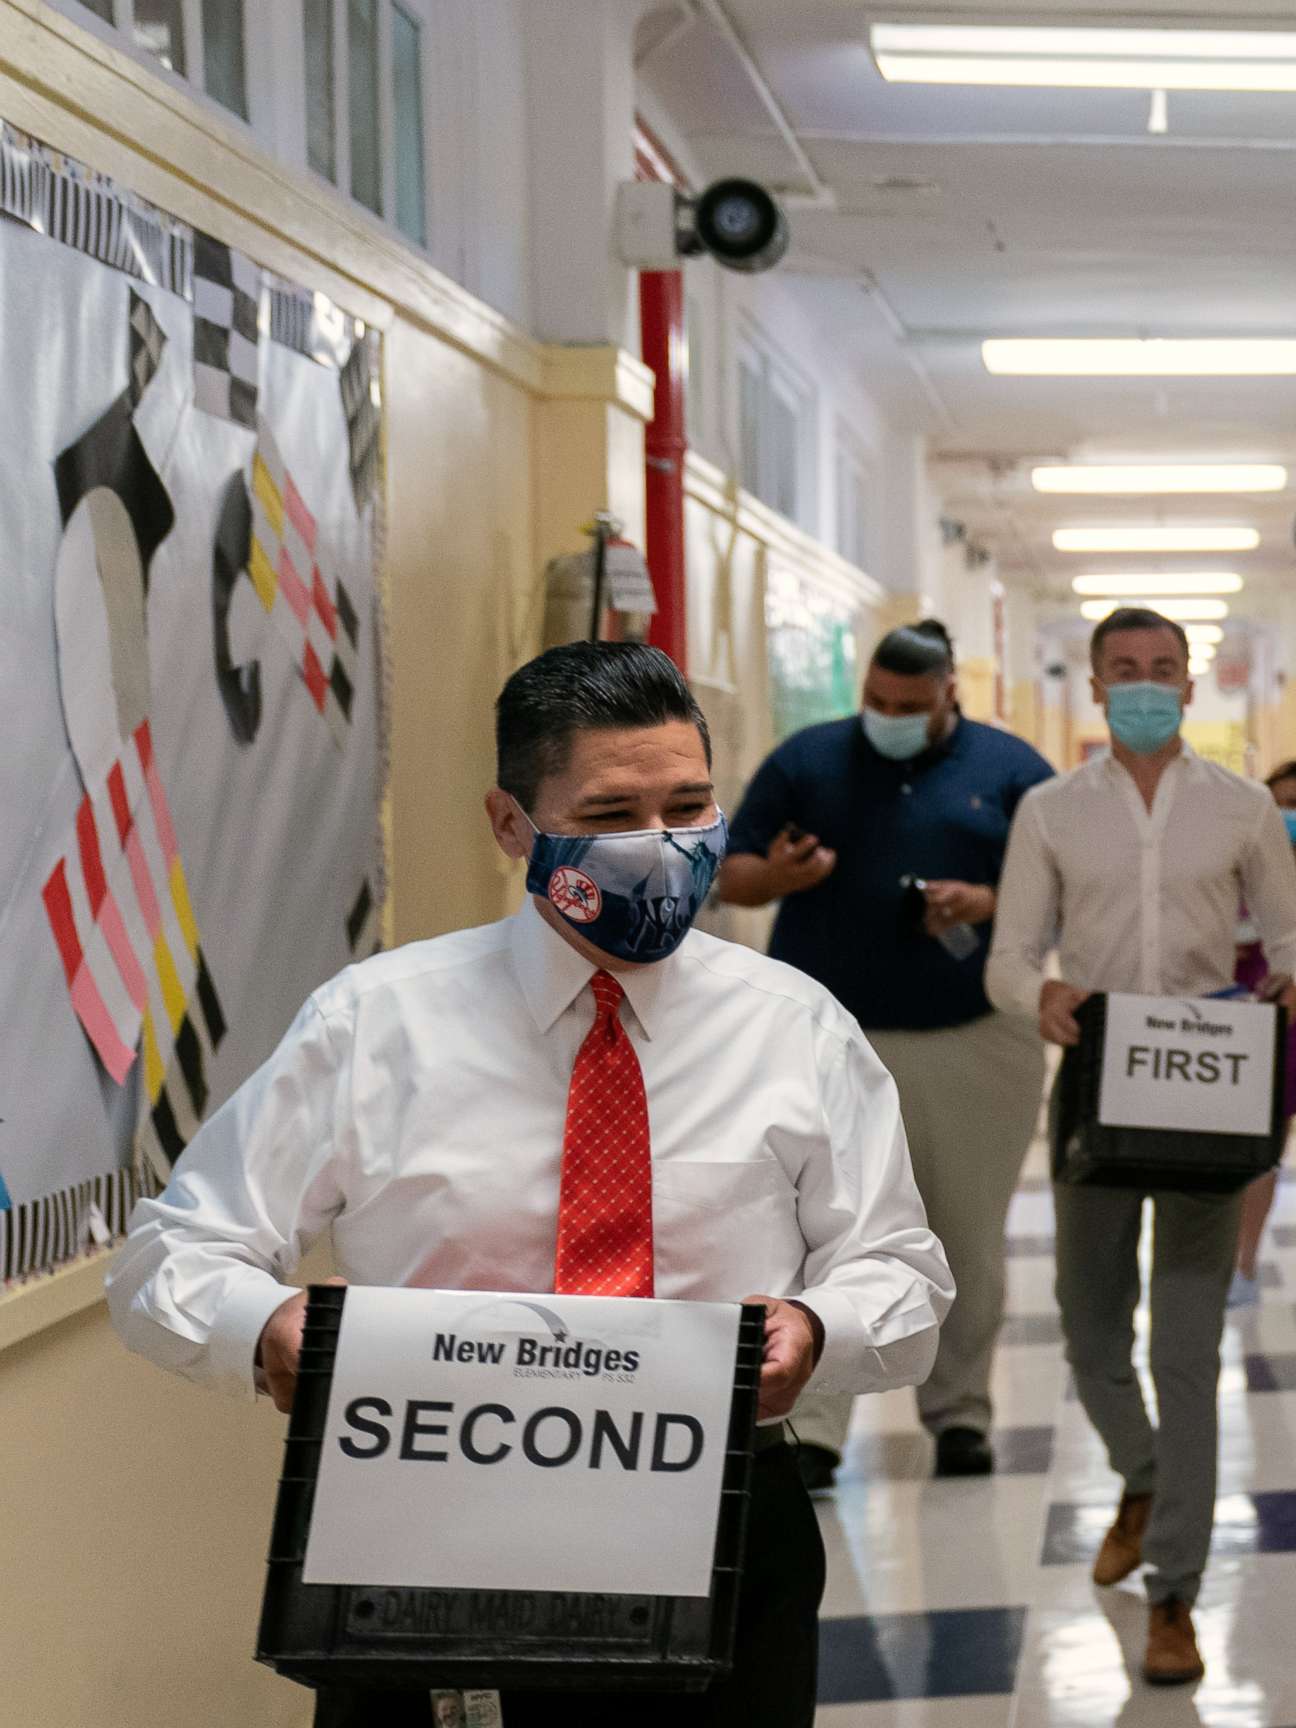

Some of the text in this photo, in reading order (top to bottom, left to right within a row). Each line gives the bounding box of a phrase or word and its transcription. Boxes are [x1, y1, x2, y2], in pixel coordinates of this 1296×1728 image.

[1146, 1015, 1233, 1036] New Bridges
[1126, 1045, 1249, 1085] FIRST
[432, 1333, 640, 1376] New Bridges
[338, 1396, 705, 1473] SECOND
